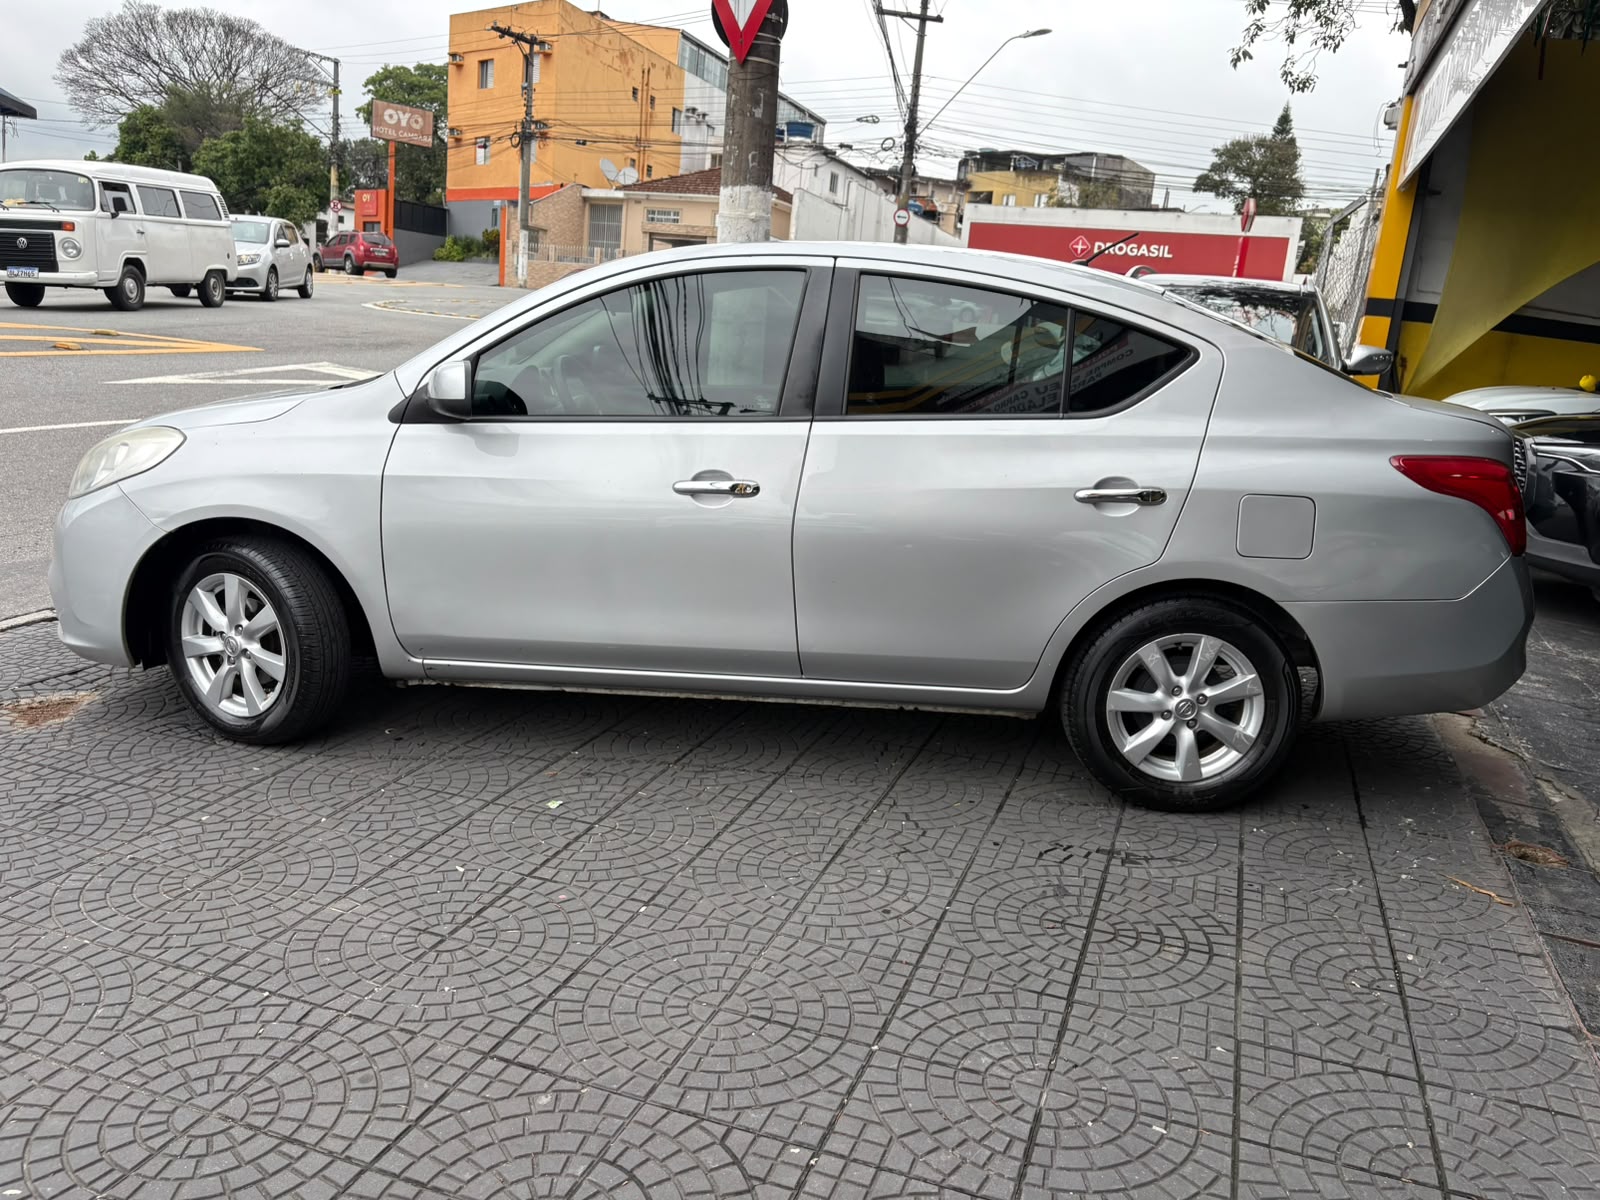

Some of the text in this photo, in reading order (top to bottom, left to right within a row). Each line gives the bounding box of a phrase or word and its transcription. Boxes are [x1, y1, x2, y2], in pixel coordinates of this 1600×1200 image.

[383, 108, 424, 130] OYO
[373, 125, 397, 137] HOTEL
[1093, 241, 1173, 258] DROGASIL
